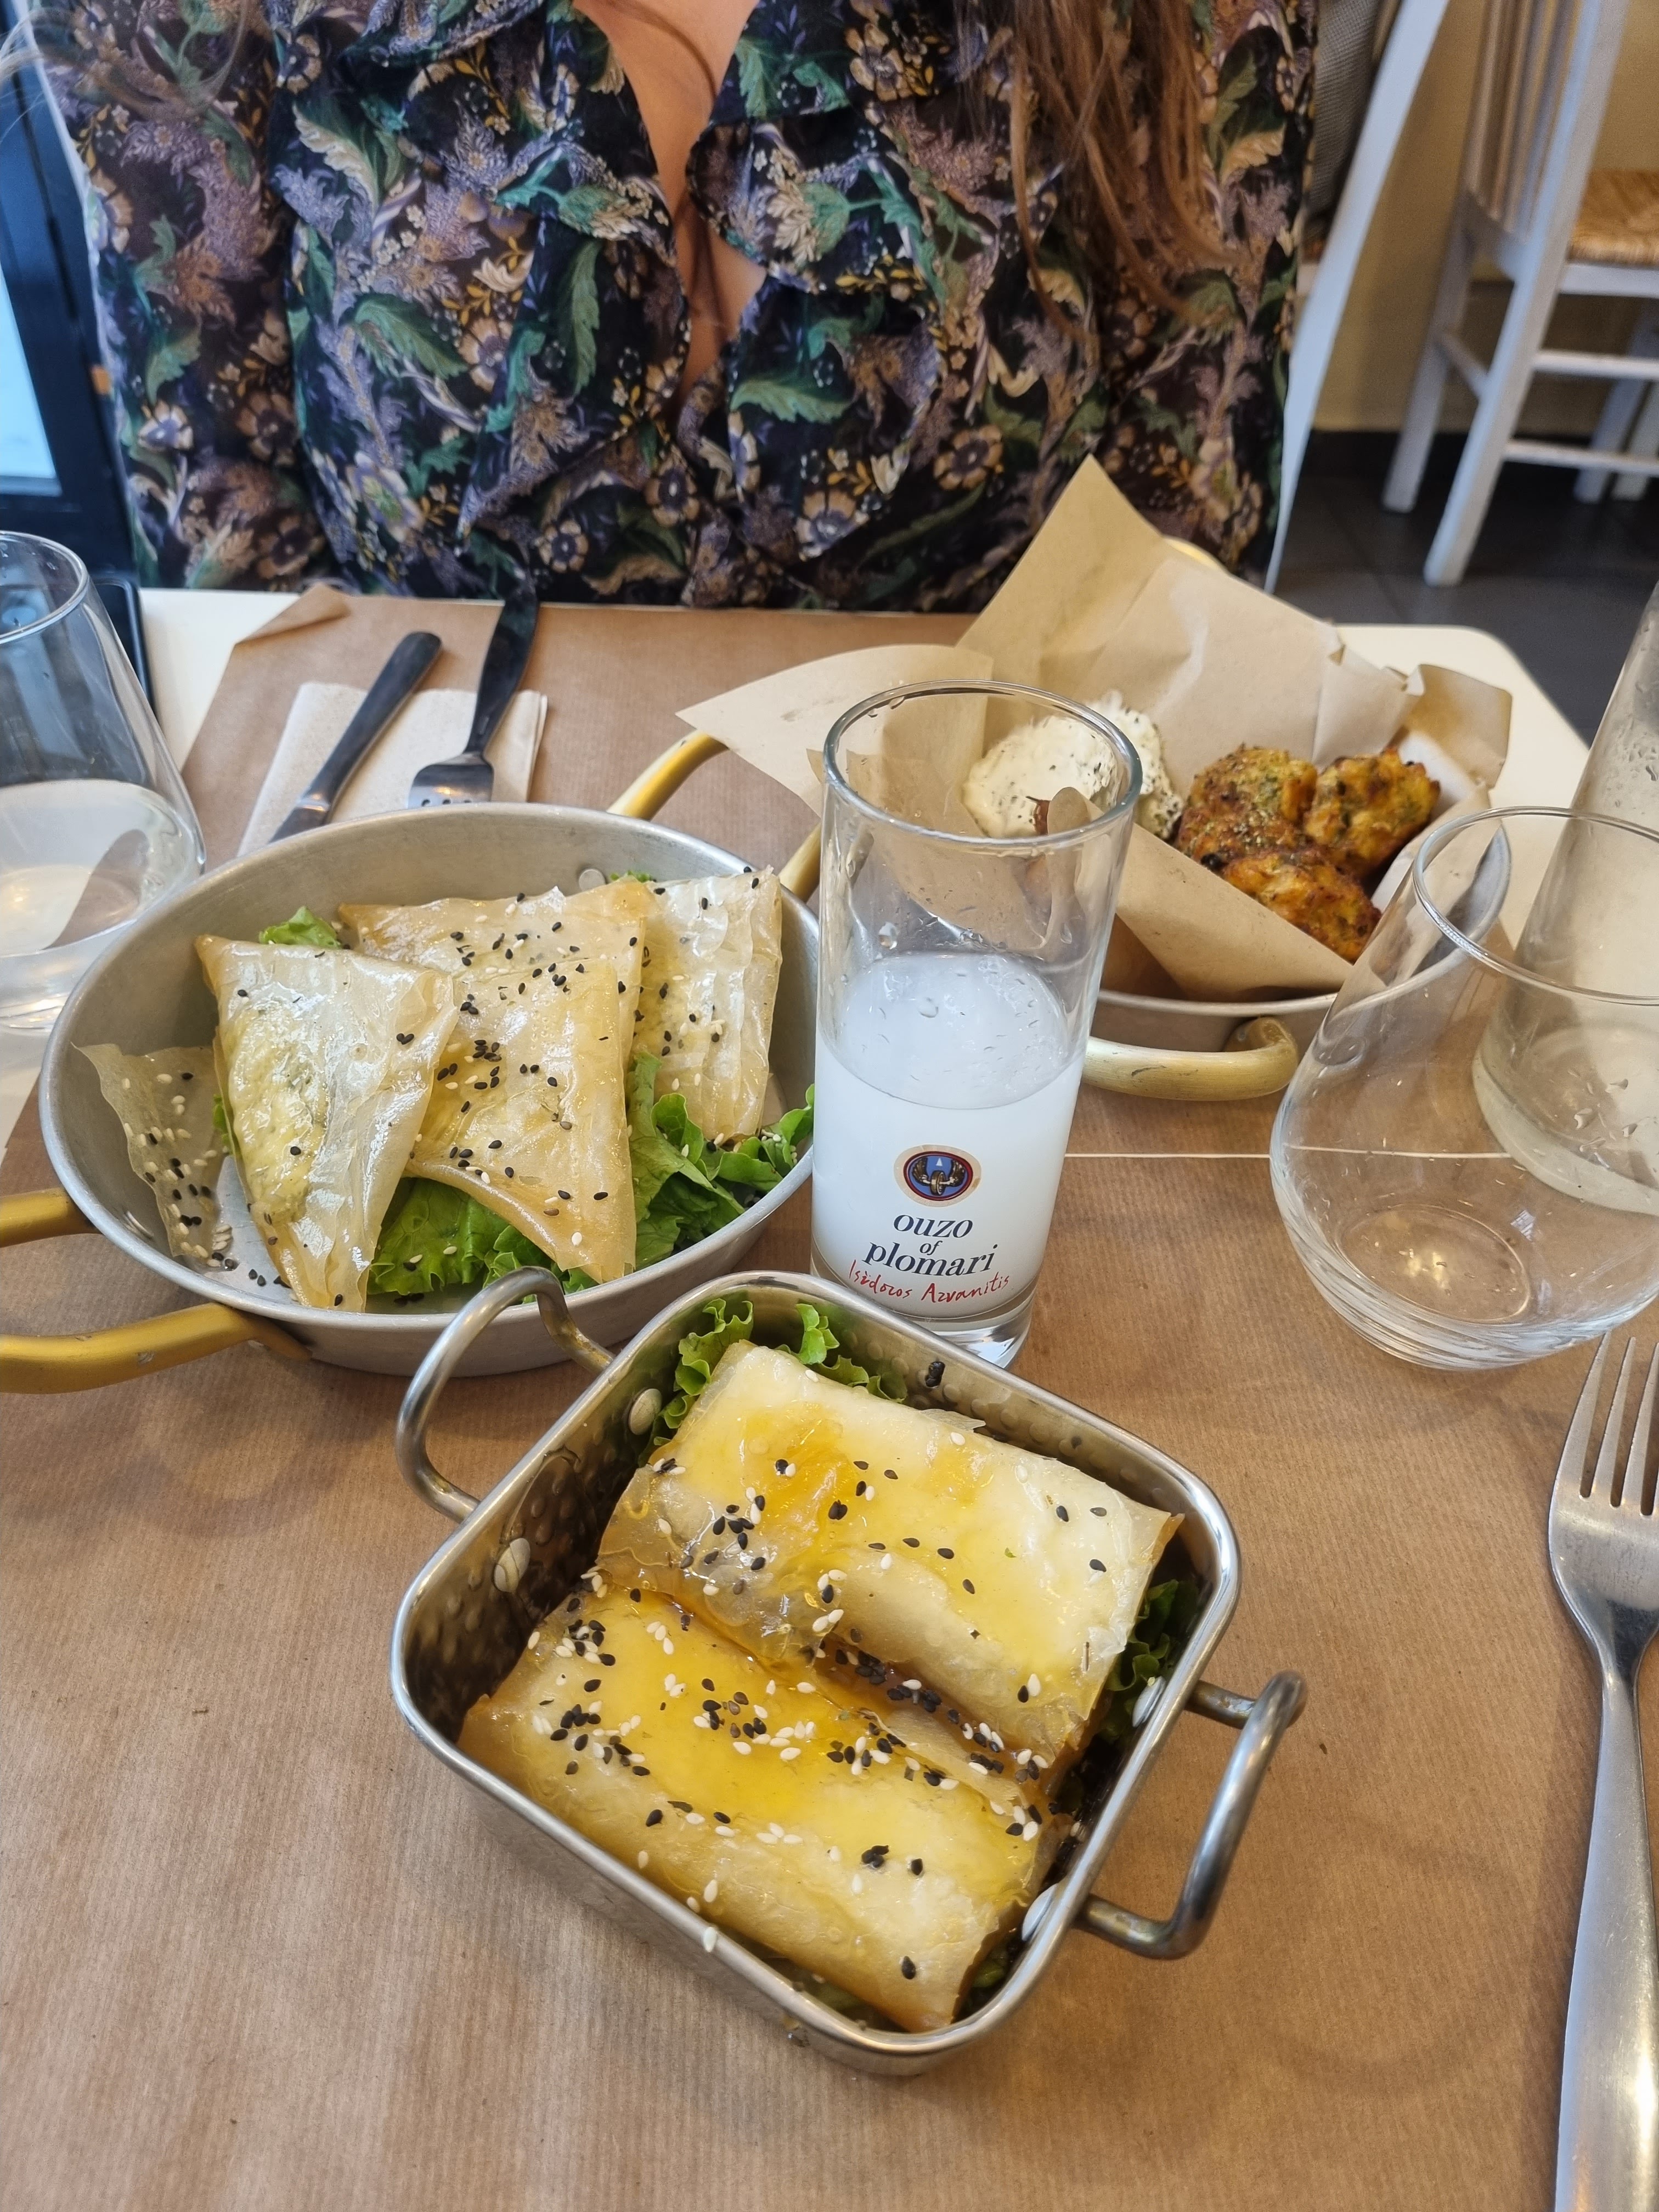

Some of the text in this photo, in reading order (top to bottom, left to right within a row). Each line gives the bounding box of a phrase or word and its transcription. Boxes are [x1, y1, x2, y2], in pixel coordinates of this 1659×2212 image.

[893, 1214, 973, 1238] ouzo
[862, 1242, 998, 1276] plomari
[919, 1240, 943, 1256] of
